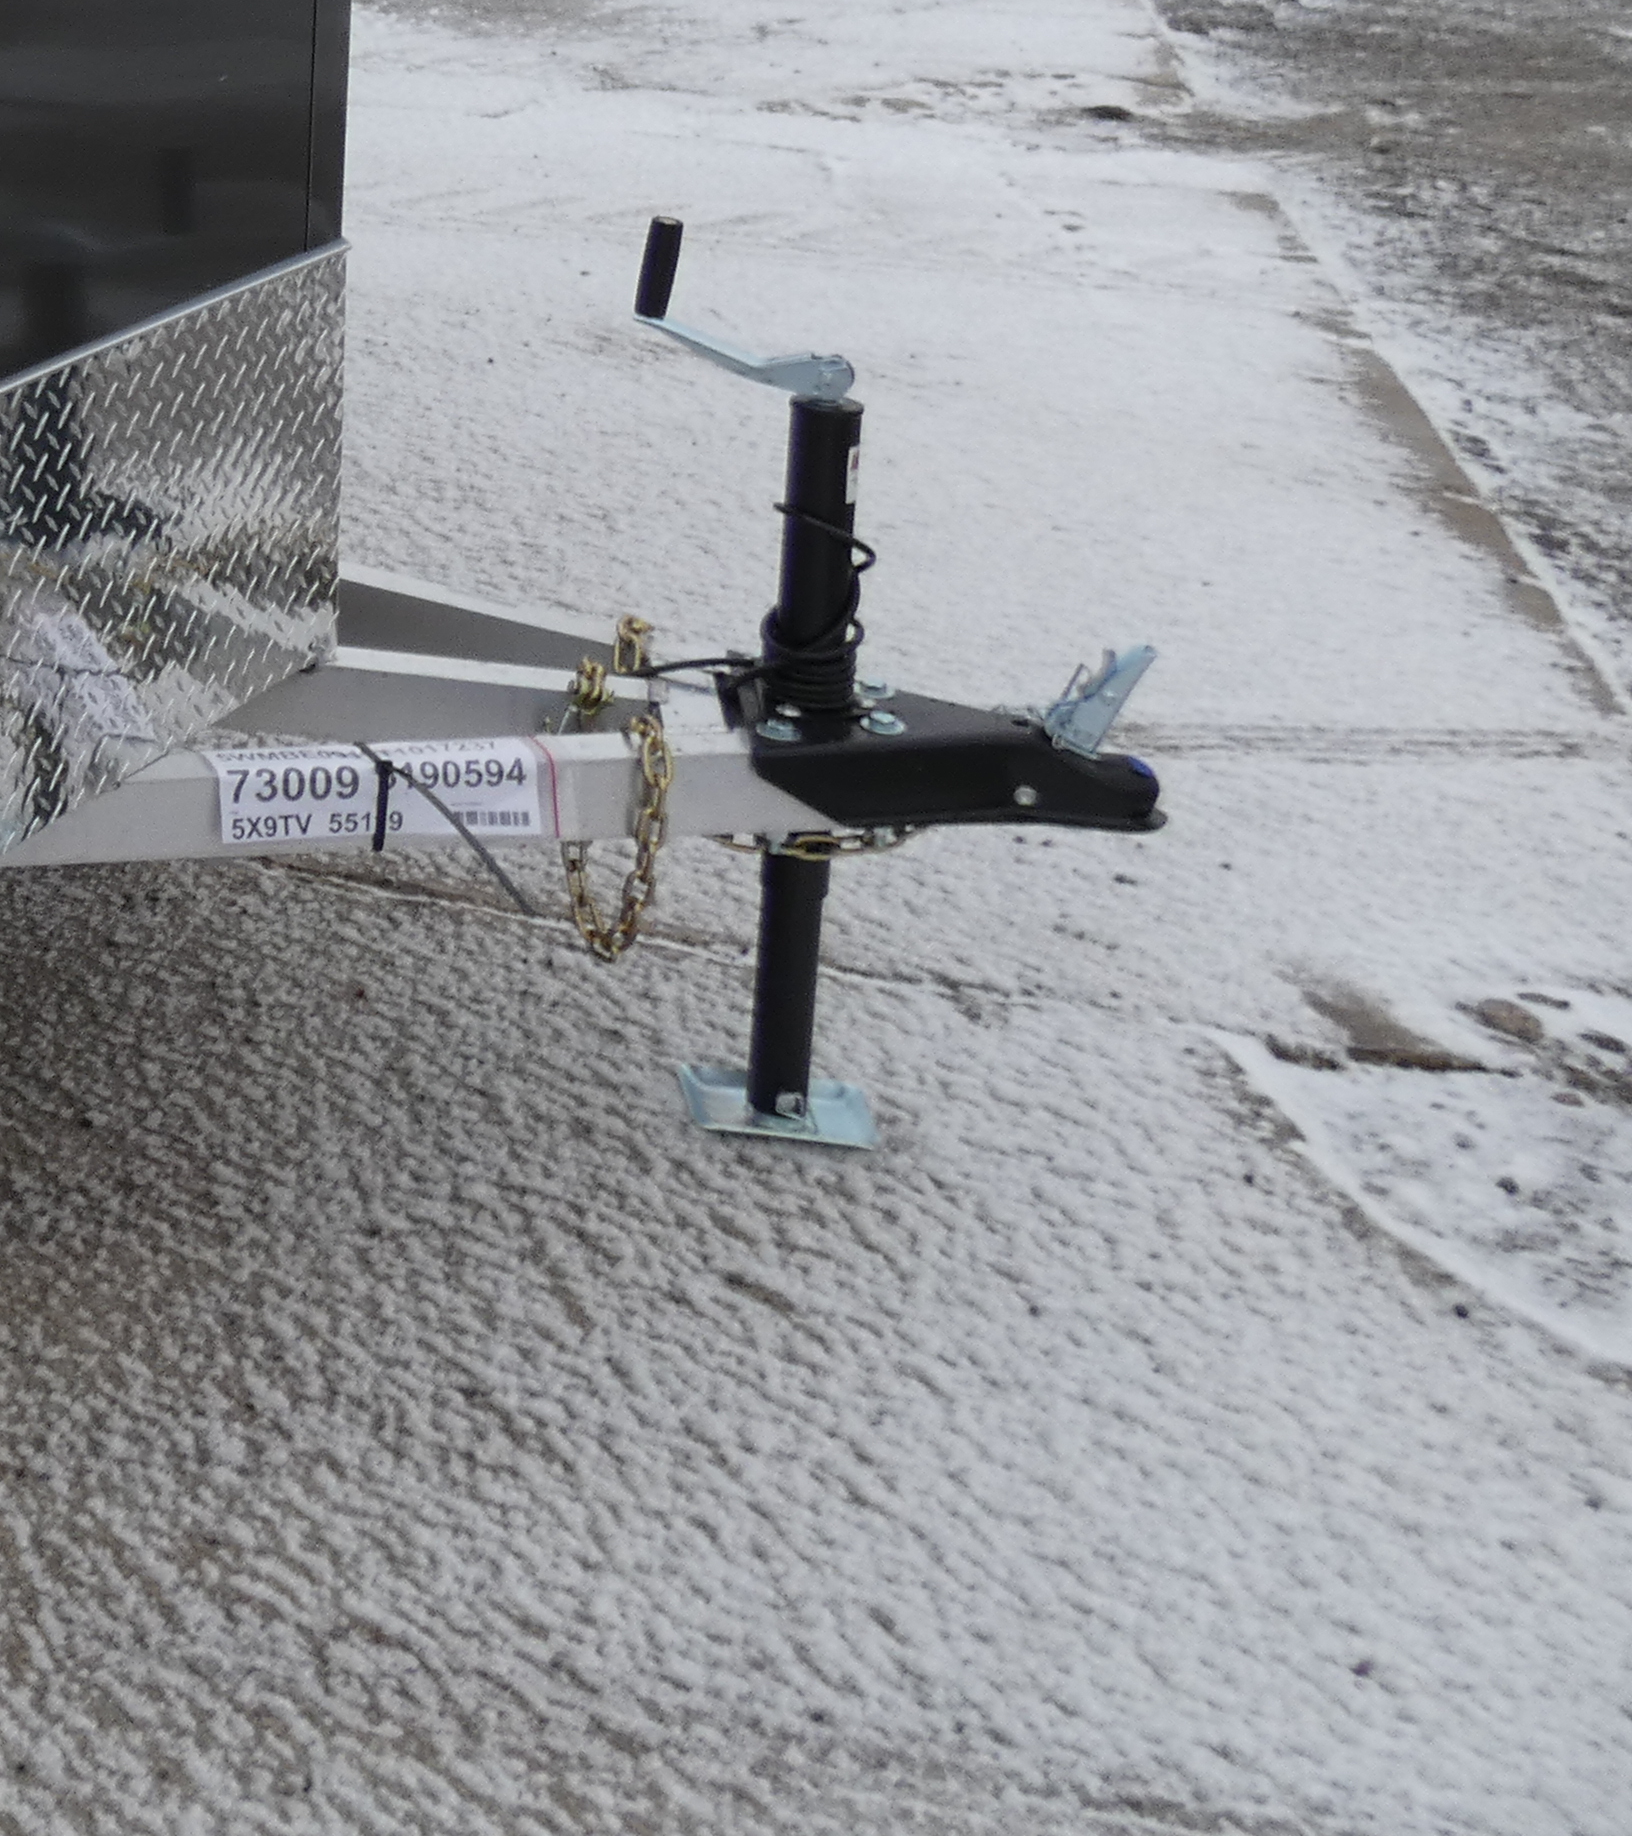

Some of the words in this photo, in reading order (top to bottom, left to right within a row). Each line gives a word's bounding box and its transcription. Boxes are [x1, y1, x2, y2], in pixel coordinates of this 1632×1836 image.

[226, 766, 360, 804] 73009
[231, 814, 313, 840] 5X9TV
[328, 811, 403, 834] 5519
